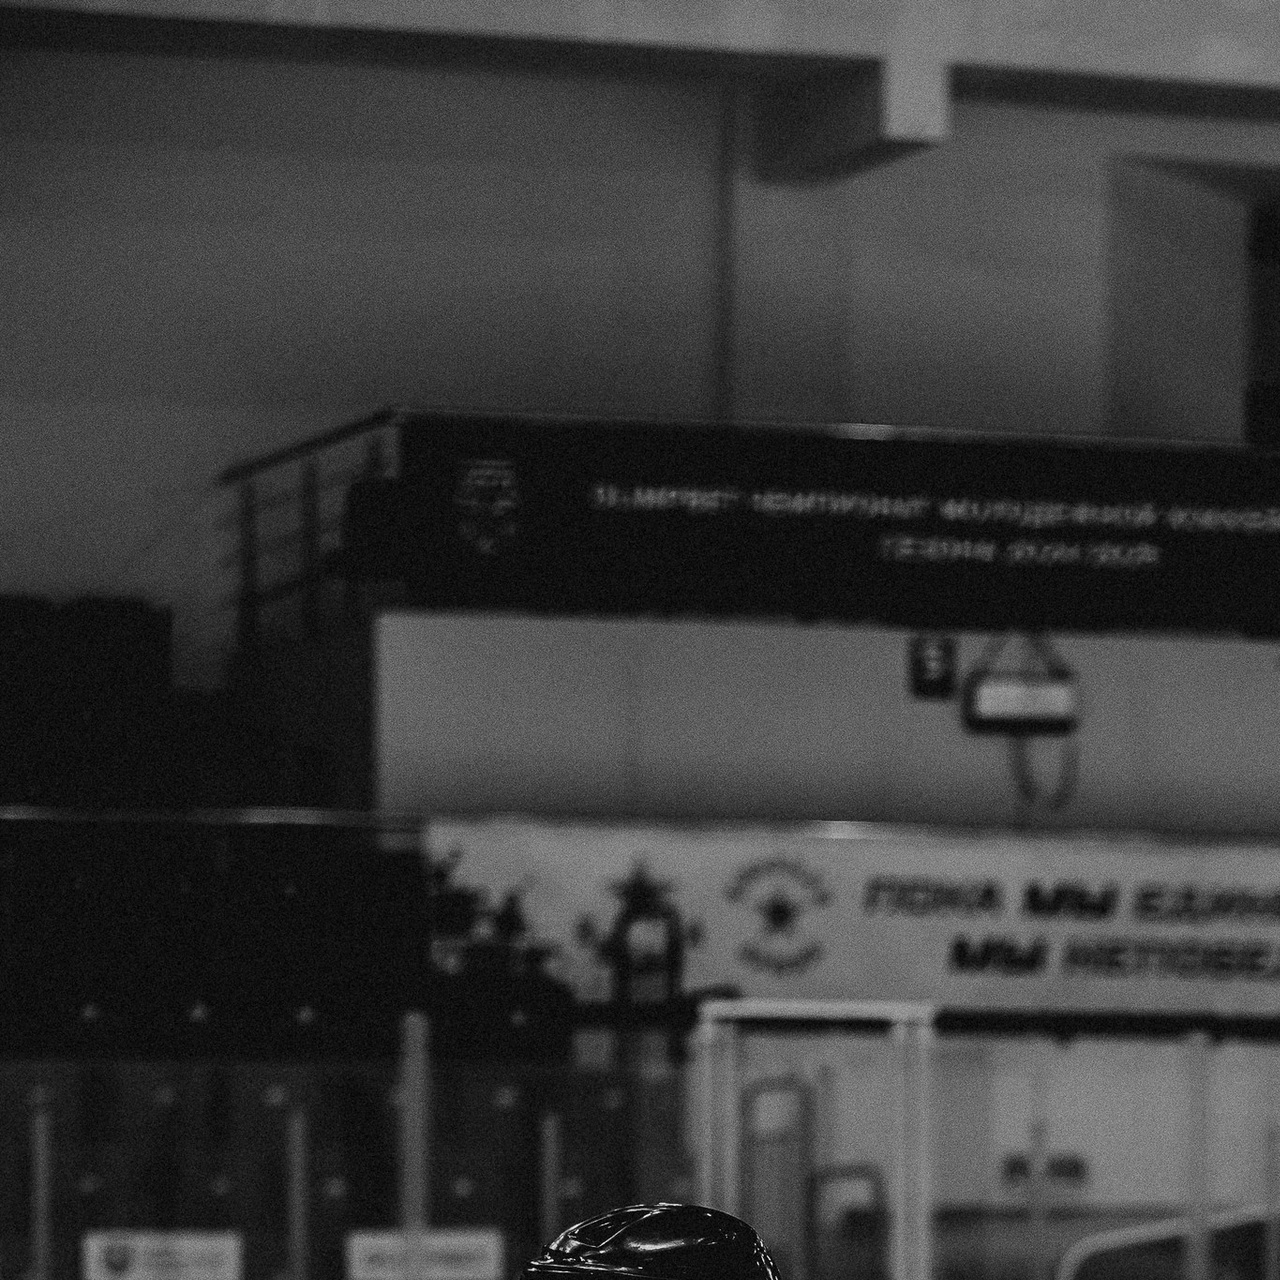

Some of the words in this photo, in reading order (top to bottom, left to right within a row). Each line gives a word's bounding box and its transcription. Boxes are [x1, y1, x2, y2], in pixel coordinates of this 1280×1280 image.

[863, 876, 1002, 917] ПОКА
[1023, 880, 1118, 920] МЫ
[948, 935, 1047, 976] МЫ
